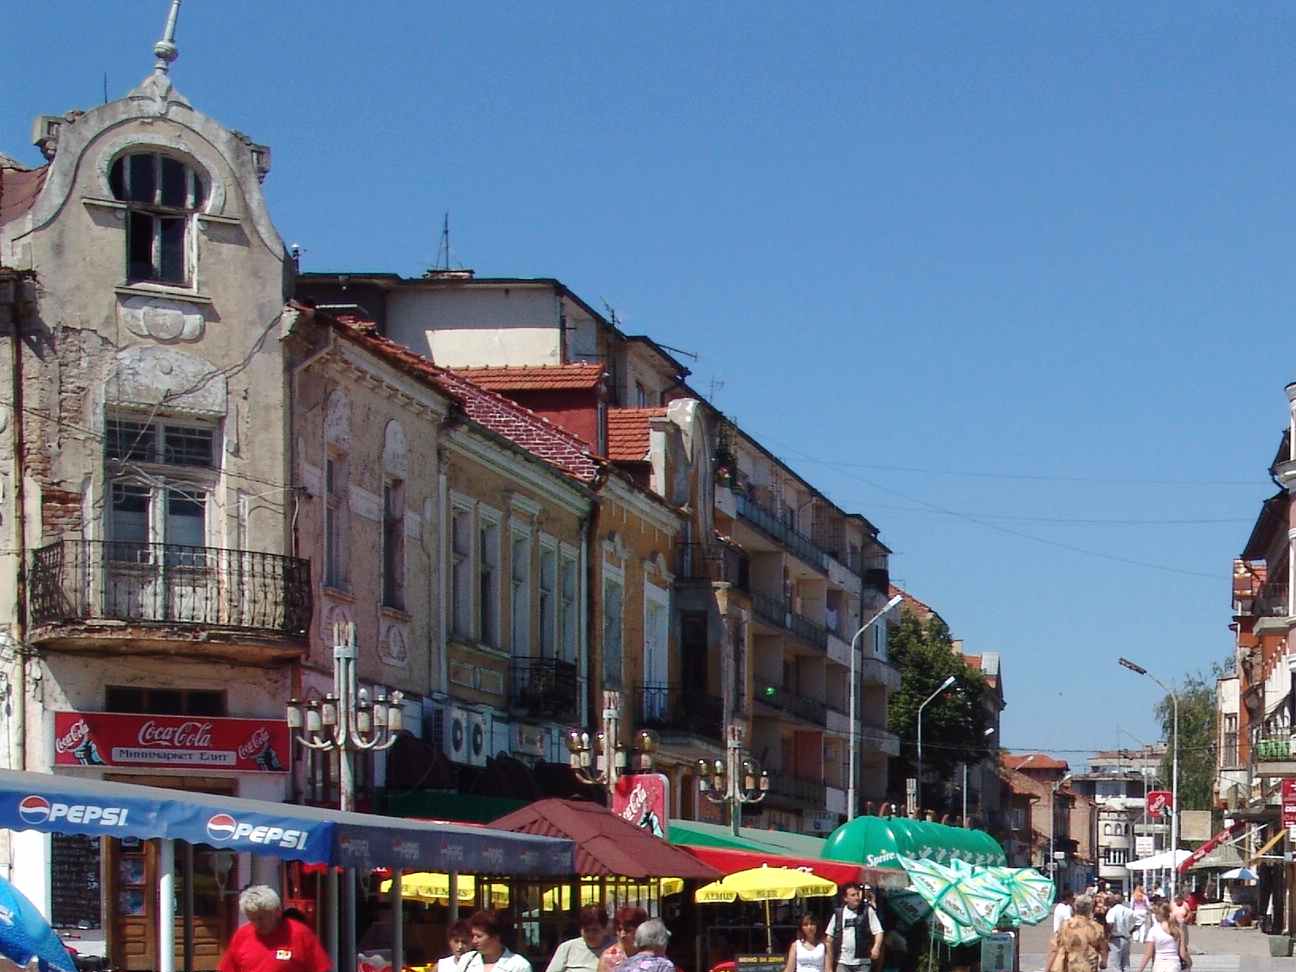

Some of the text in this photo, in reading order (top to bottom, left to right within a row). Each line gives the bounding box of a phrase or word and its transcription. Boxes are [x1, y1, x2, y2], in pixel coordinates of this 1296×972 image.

[137, 720, 214, 747] Coca-Cola
[119, 749, 193, 761] Минимаркет
[49, 802, 129, 827] PEPSI
[233, 822, 308, 851] PEPSI
